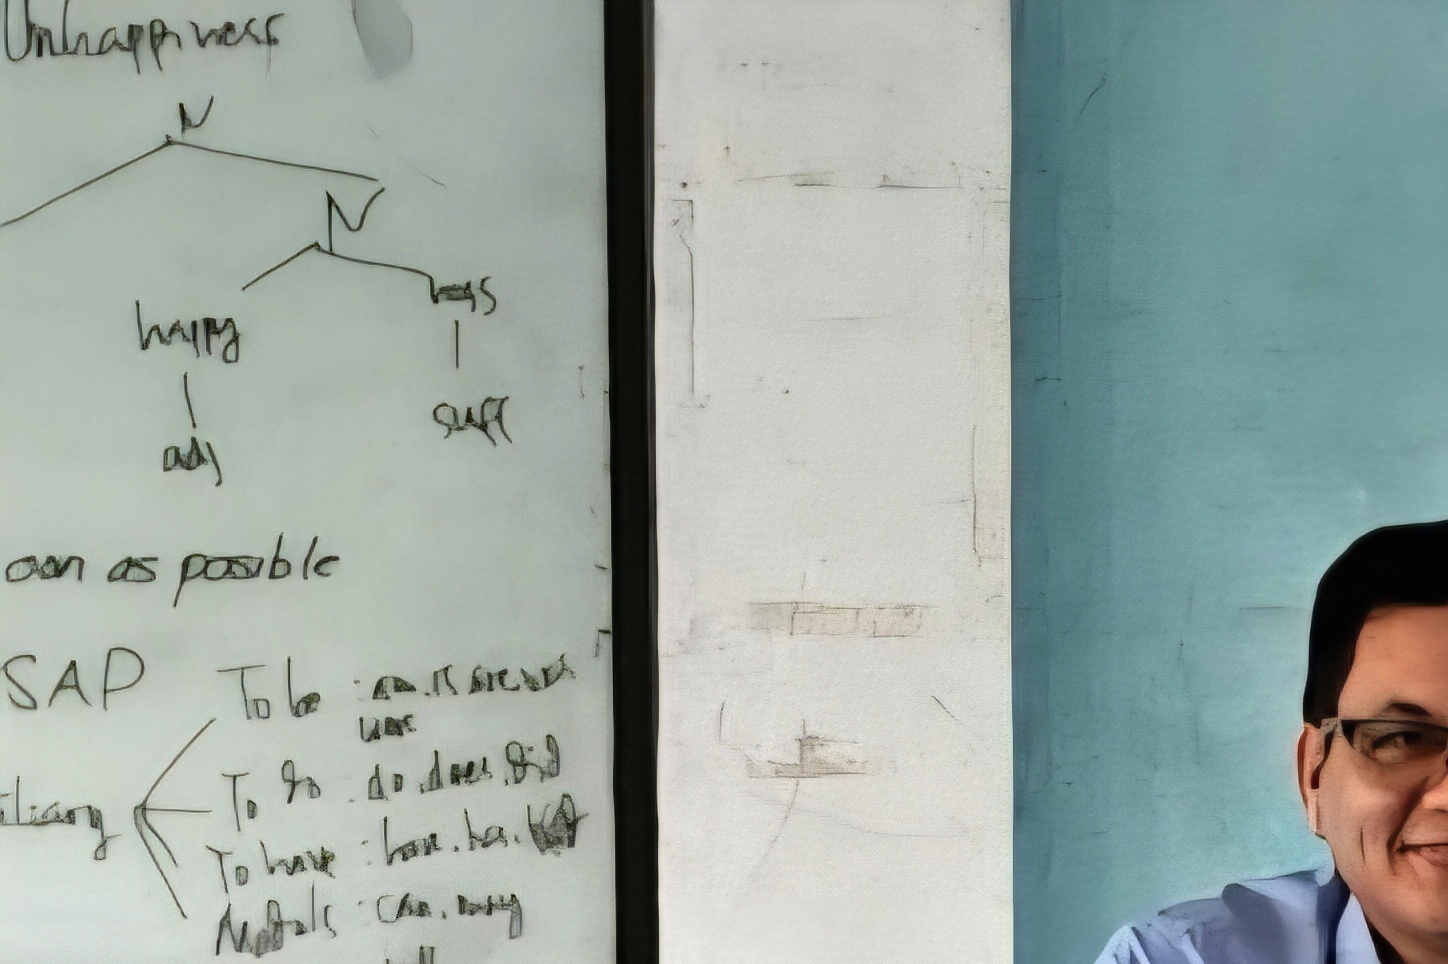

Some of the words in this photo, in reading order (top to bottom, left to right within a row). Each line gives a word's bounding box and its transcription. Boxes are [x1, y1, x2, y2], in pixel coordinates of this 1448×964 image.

[325, 186, 386, 255] N
[135, 299, 242, 364] happy
[107, 555, 159, 583] as
[0, 646, 145, 711] SAP
[216, 664, 270, 720] To
[221, 772, 258, 832] To
[205, 844, 248, 894] To
